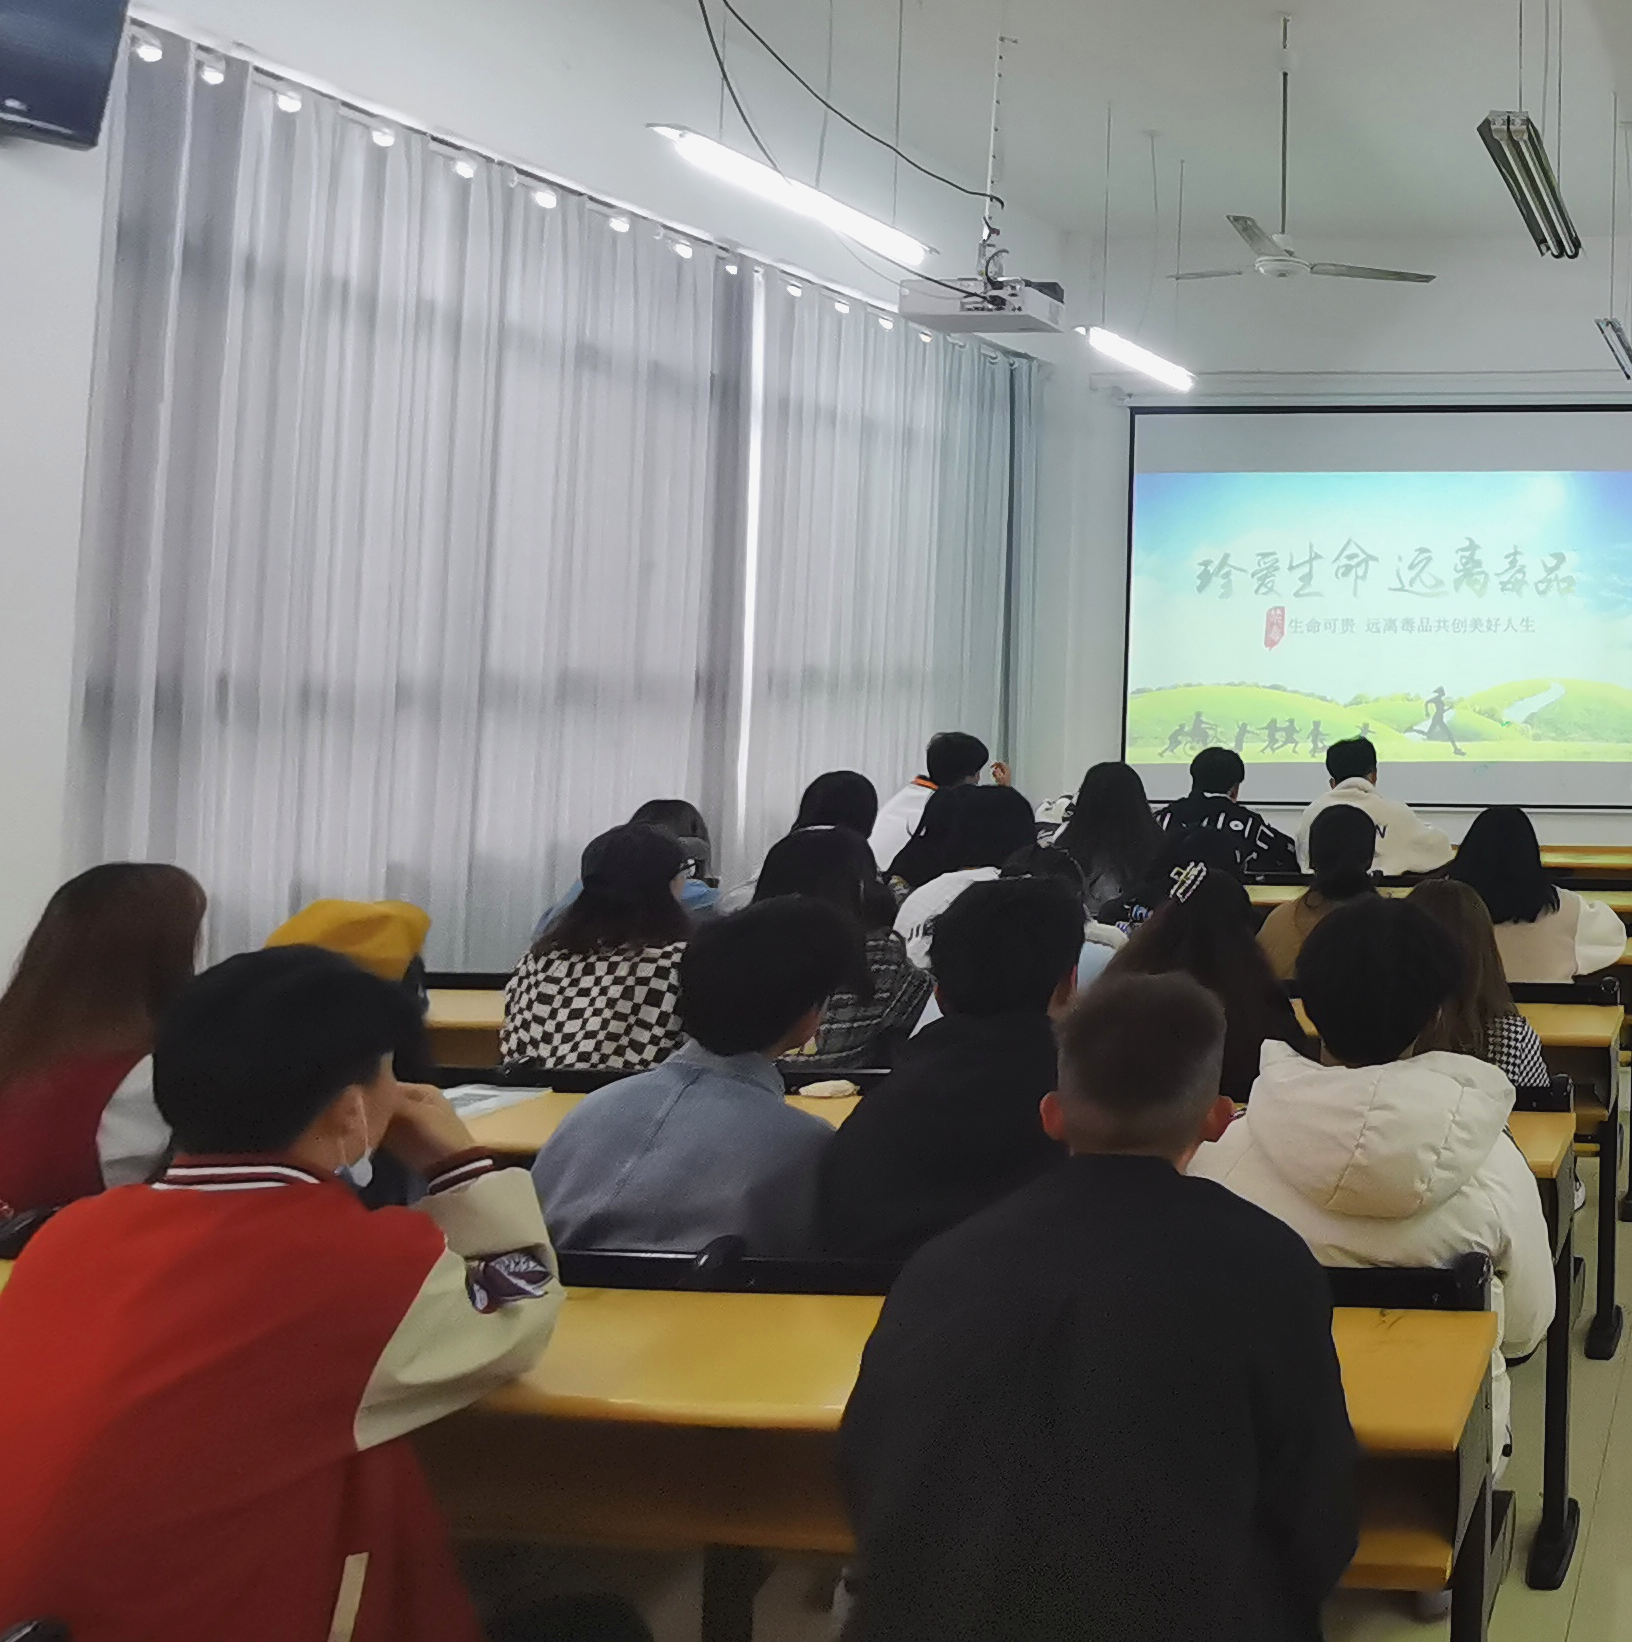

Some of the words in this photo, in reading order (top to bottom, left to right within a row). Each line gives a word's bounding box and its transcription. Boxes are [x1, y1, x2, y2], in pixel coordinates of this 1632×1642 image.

[1195, 537, 1379, 599] 珍爱生命
[1387, 536, 1577, 599] 远离毒品
[1365, 616, 1536, 635] 远离毒品共创美好人生
